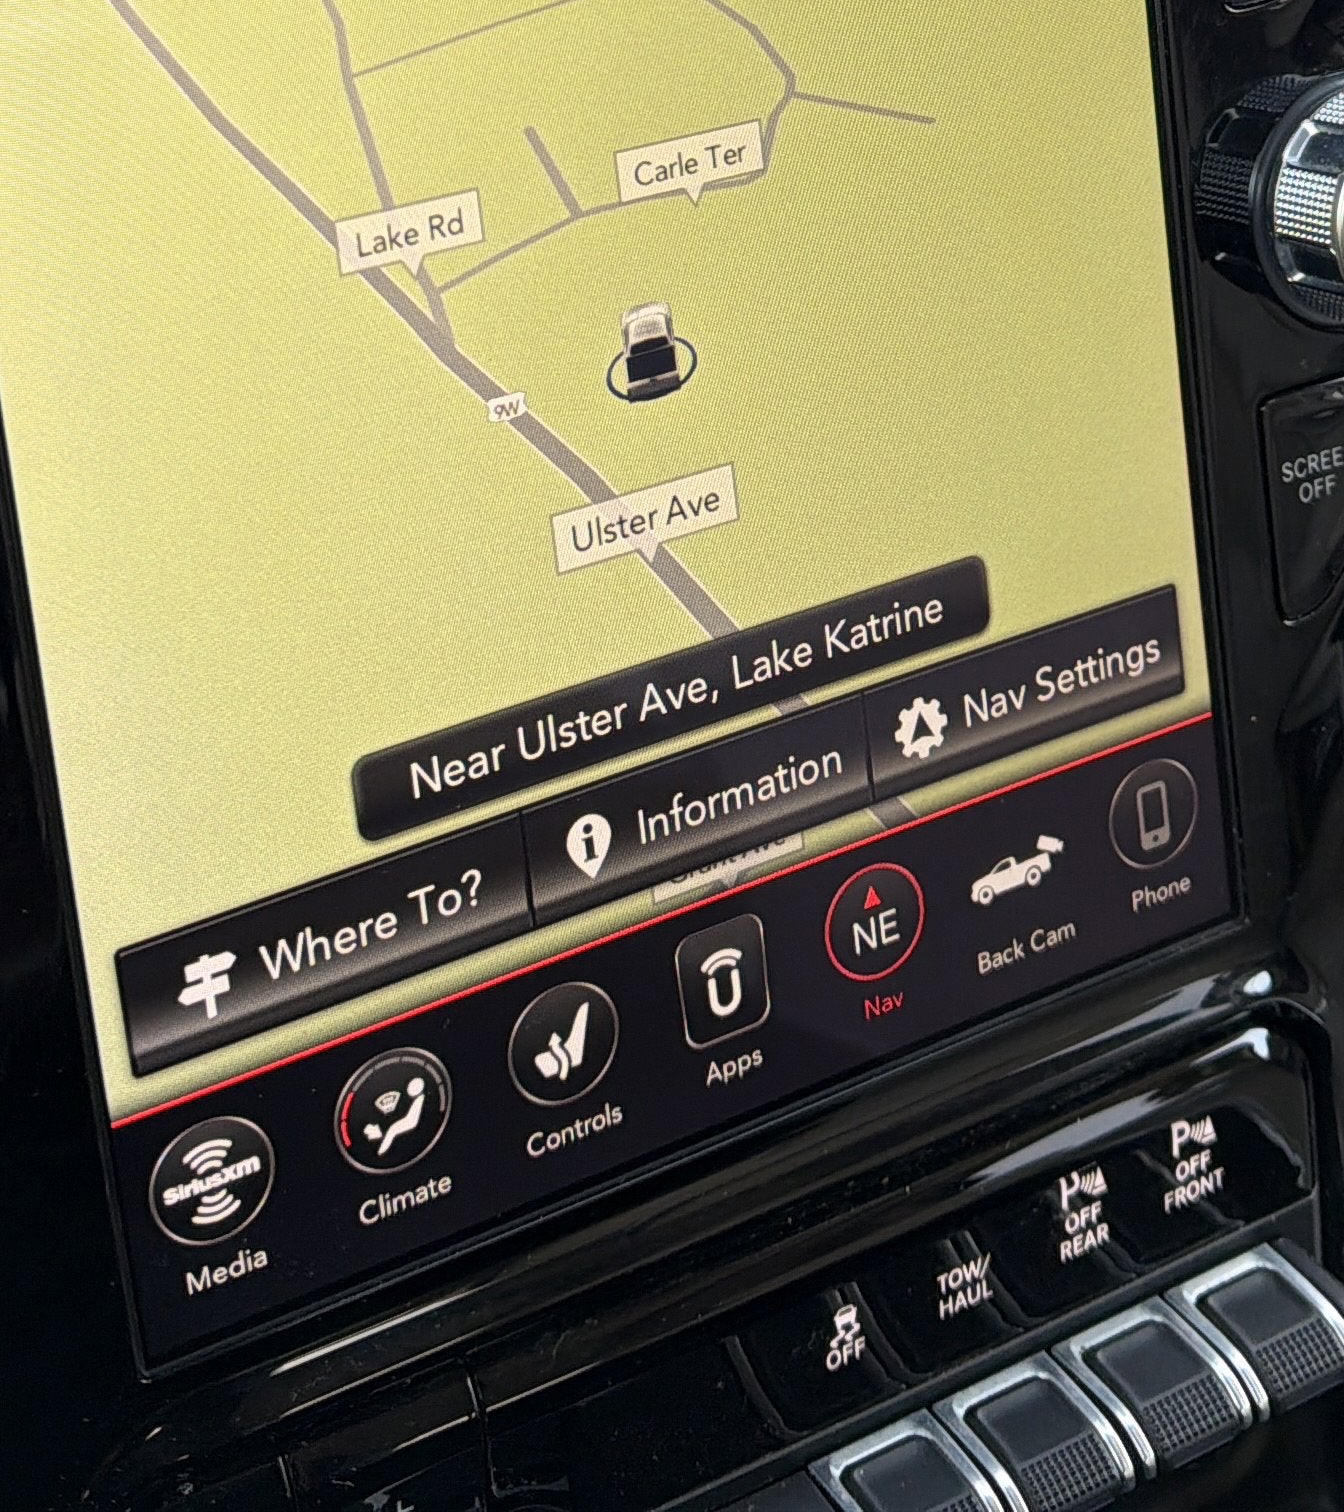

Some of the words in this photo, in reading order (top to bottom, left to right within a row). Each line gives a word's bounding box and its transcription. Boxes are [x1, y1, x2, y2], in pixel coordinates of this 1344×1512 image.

[633, 149, 698, 188] Carle
[703, 141, 747, 169] Ter
[356, 222, 421, 258] Lake
[427, 211, 466, 243] Rd
[1298, 476, 1336, 505] OFF
[571, 503, 658, 553] Ulster
[664, 488, 722, 526] Ave
[408, 742, 507, 801] Near
[516, 699, 627, 763] Ulster
[637, 677, 719, 727] Ave,
[730, 636, 813, 693] Lake
[822, 593, 945, 660] Katrine
[962, 682, 1028, 730] Nav
[1035, 638, 1161, 703] Settings
[636, 748, 843, 845] Information
[1130, 873, 1193, 912] Phone
[259, 909, 399, 981] Where
[407, 869, 484, 927] To?
[851, 911, 902, 958] NE
[977, 937, 1025, 976] Back
[1029, 920, 1077, 958] Cam
[863, 988, 905, 1019] Nav
[706, 1045, 764, 1087] Apps
[526, 1105, 623, 1157] Controls
[1176, 1149, 1212, 1182] OFF
[358, 1171, 453, 1226] Climate
[1164, 1166, 1226, 1214] FRONT
[1064, 1202, 1102, 1235] OFF
[1060, 1224, 1110, 1263] REAR
[185, 1246, 269, 1296] Media
[937, 1253, 991, 1292] TOW/
[939, 1284, 994, 1320] HAUL
[825, 1335, 866, 1372] OFF
